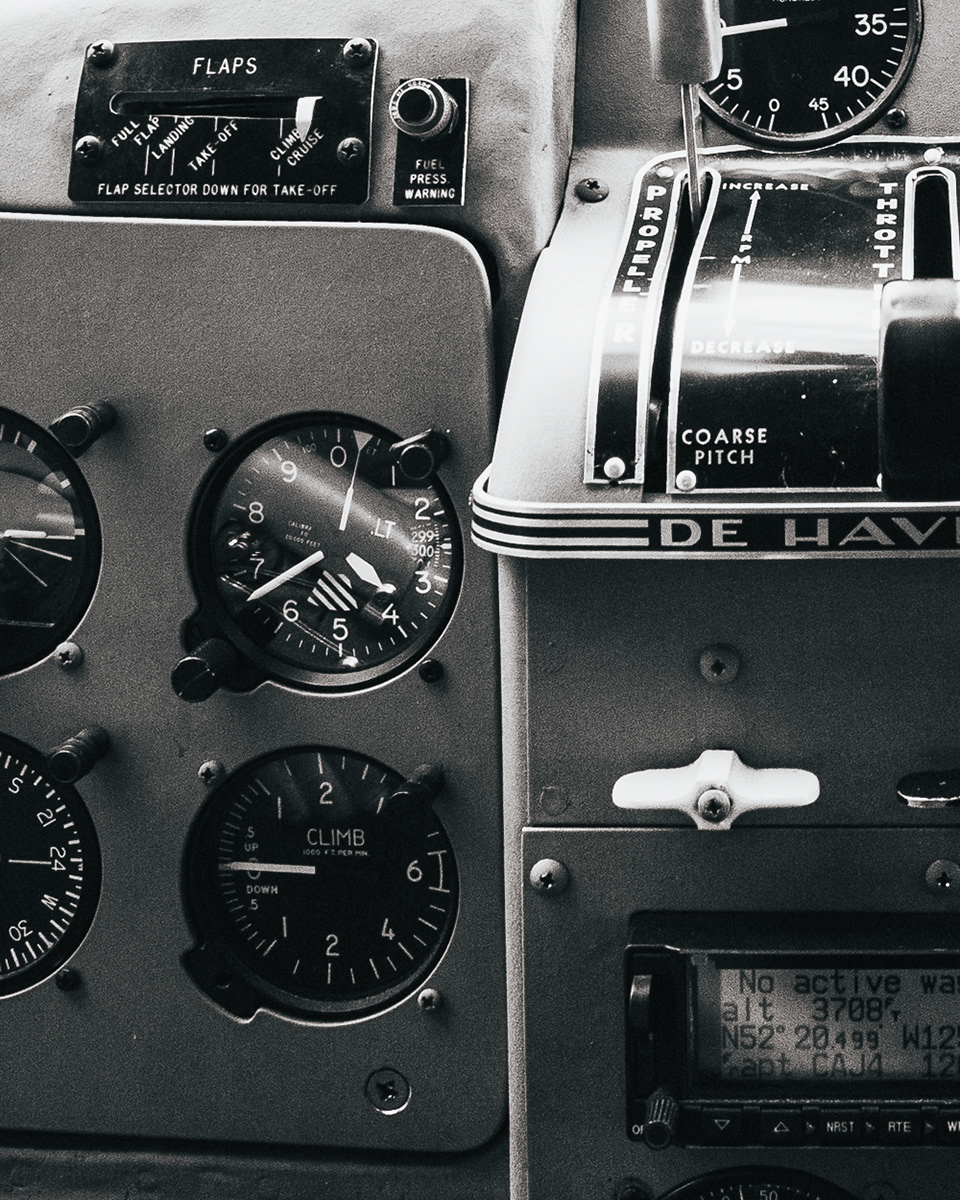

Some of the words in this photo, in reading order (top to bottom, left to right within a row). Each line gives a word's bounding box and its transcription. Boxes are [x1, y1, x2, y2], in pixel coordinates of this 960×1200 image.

[854, 14, 888, 36] 35
[192, 57, 258, 75] FLAPS
[834, 65, 869, 87] 40
[727, 69, 743, 90] 5
[769, 98, 780, 112] 0
[808, 98, 829, 111] 45
[110, 120, 141, 148] FULL
[133, 115, 161, 147] FLAP
[151, 116, 195, 161] LANDING
[187, 120, 239, 172] TAKE-OFF
[269, 127, 303, 161] CLIMB
[286, 129, 325, 168] CRUISE
[415, 158, 444, 171] FUEL
[97, 183, 130, 195] FLAP
[133, 184, 198, 196] SELECTOR
[202, 184, 239, 196] DOWN
[242, 184, 268, 196] FOR
[273, 184, 338, 197] TAKE-OFF
[404, 188, 456, 199] WARNING
[721, 182, 809, 191] INCREASE
[731, 235, 753, 265] RPM
[690, 340, 796, 354] DECREASE
[681, 428, 768, 445] COARSE
[330, 445, 347, 468] 0
[694, 449, 754, 465] PITCH
[281, 460, 298, 483] 9
[248, 501, 264, 524] 8
[414, 497, 431, 521] 2
[660, 518, 750, 548] DE
[250, 557, 265, 579] 7
[414, 571, 432, 594] 3
[282, 600, 300, 622] 6
[382, 603, 400, 625] 4
[332, 618, 349, 641] 5
[319, 781, 333, 805] 2
[245, 843, 259, 852] UP
[307, 828, 365, 846] CLIMB
[407, 860, 423, 882] 6
[246, 885, 278, 895] DOWN
[381, 918, 395, 940] 4
[325, 934, 339, 956] 2
[739, 970, 774, 994] No
[794, 970, 901, 994] active
[826, 1121, 855, 1133] NRST
[887, 1121, 912, 1133] RTE
